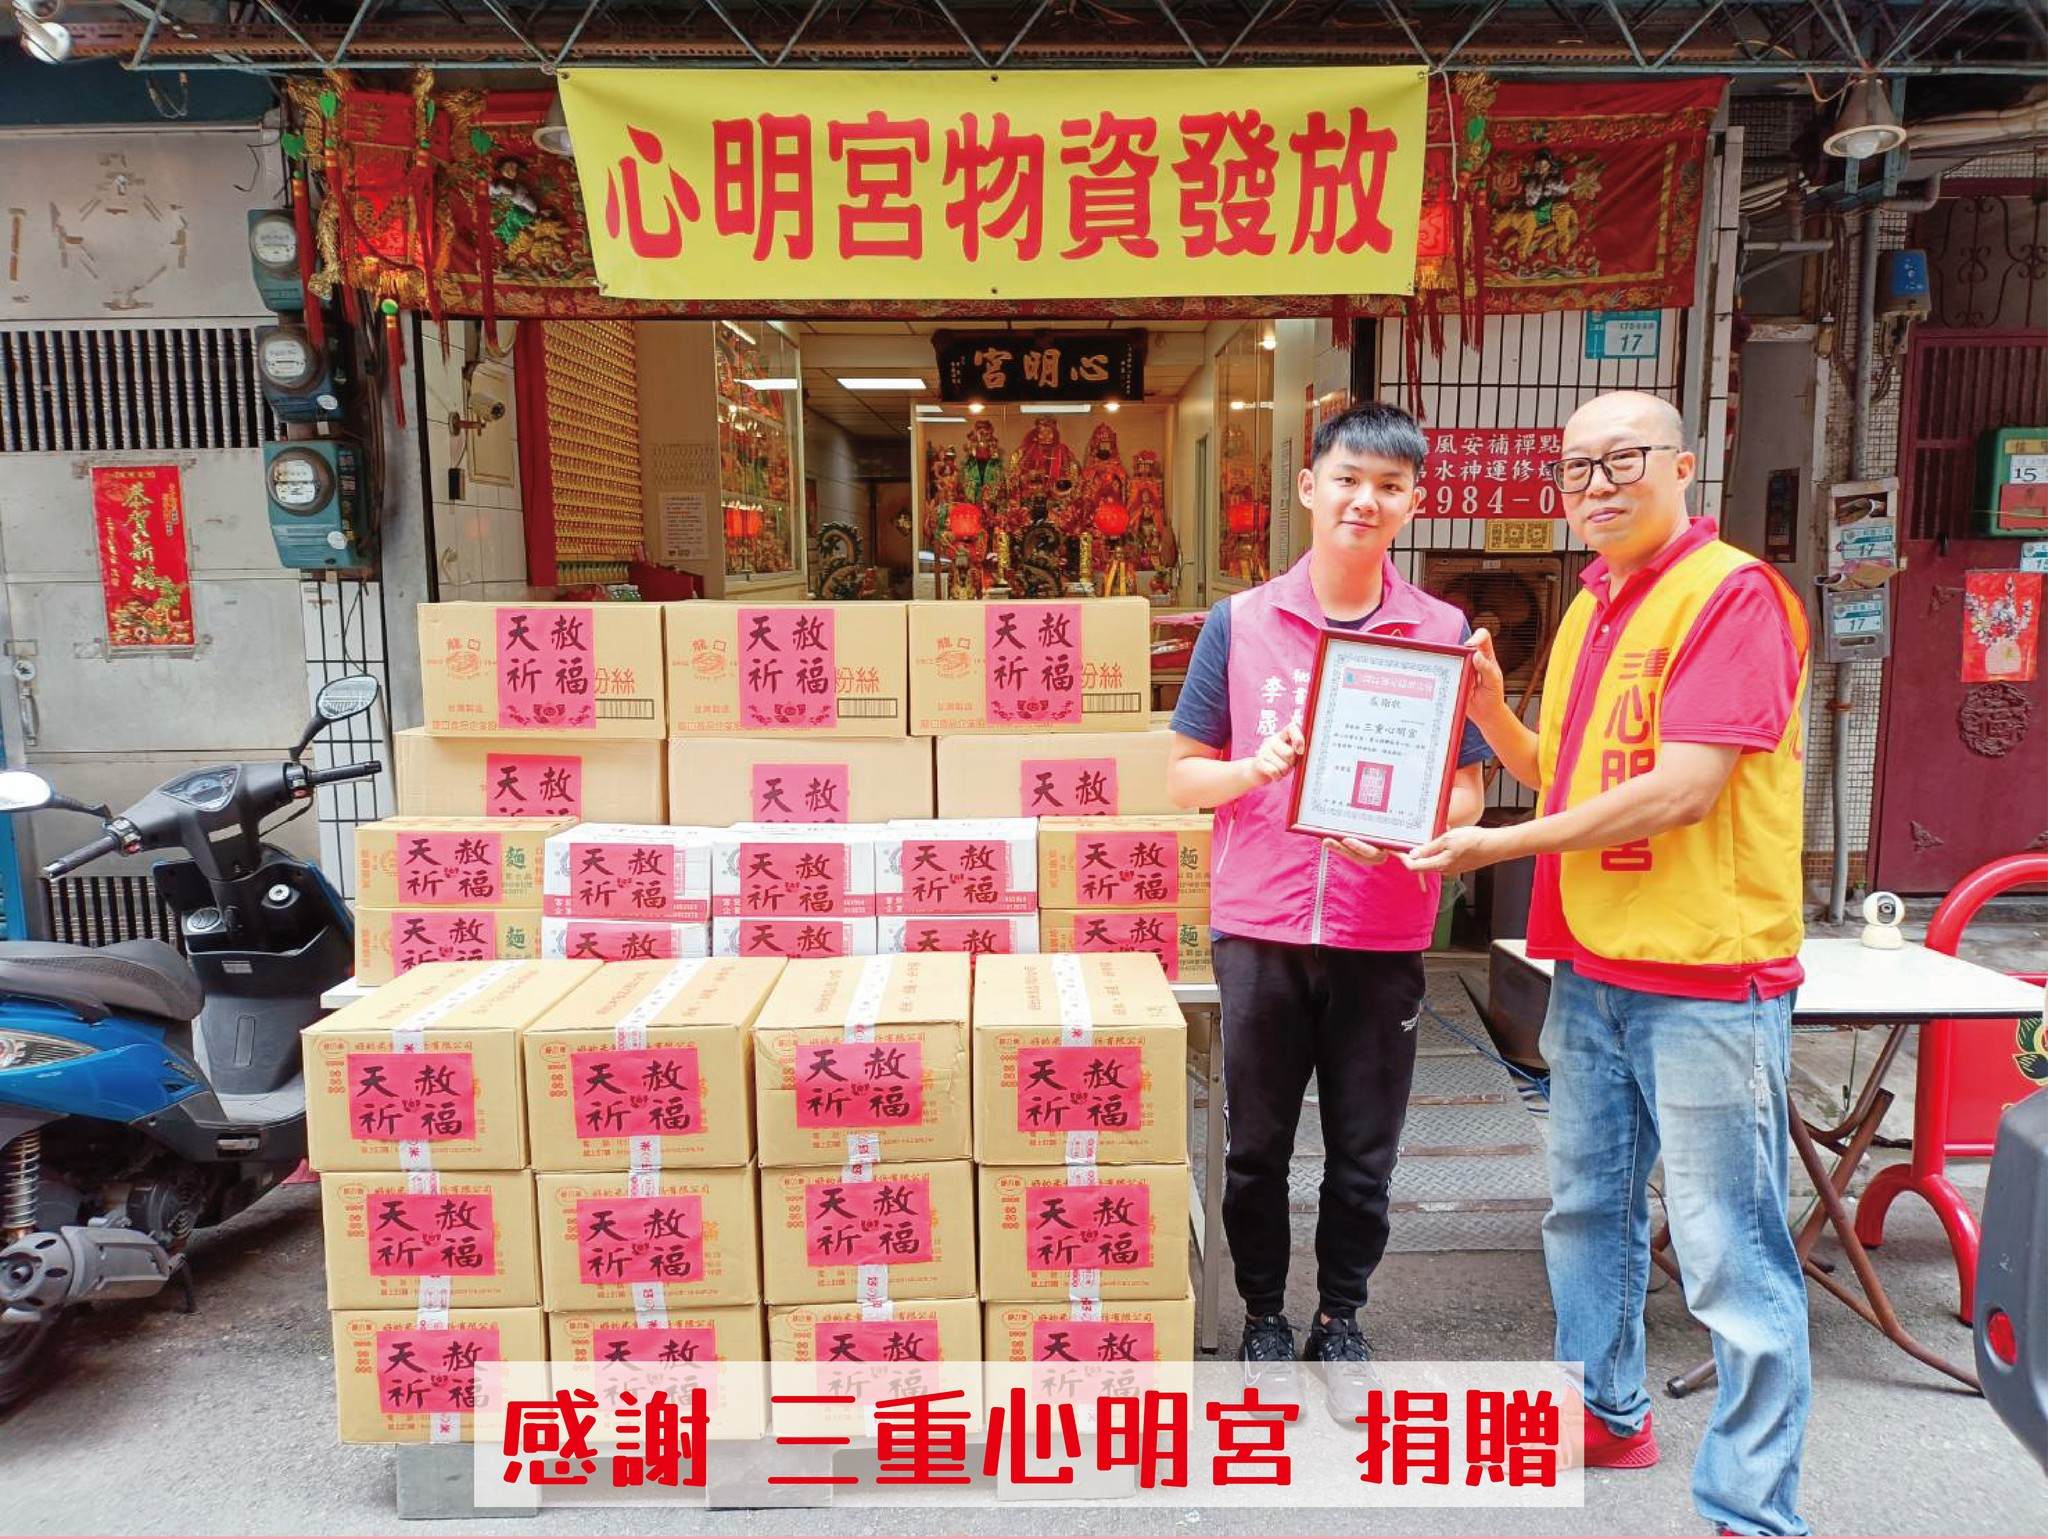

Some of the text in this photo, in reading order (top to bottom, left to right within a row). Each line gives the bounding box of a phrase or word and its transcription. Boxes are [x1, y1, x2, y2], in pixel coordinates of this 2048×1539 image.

[606, 108, 1397, 261] 心明宮物資發放
[1621, 334, 1643, 353] 17
[2015, 468, 2037, 482] 15
[1860, 544, 1875, 557] 17
[506, 615, 587, 652] 天赦
[747, 615, 828, 652] 天赦
[992, 612, 1074, 650] 天赦
[1850, 618, 1865, 631] 17
[507, 658, 589, 695] 祈福
[748, 658, 829, 695] 祈福
[993, 655, 1074, 692] 祈福
[494, 765, 577, 802] 天赦
[760, 777, 839, 814] 天赦
[1031, 771, 1107, 808] 天赦
[406, 838, 494, 866] 天赦
[579, 848, 666, 876] 天赦
[747, 853, 833, 880] 天赦
[912, 844, 999, 872] 天赦
[1082, 842, 1167, 870] 天赦
[407, 870, 494, 898] 祈福
[580, 880, 667, 909] 祈福
[747, 884, 833, 913] 祈福
[912, 875, 998, 904] 祈福
[1083, 872, 1168, 901] 祈福
[401, 918, 489, 945] 天赦
[573, 932, 660, 959] 天赦
[750, 925, 838, 952] 天赦
[917, 929, 998, 954] 天赦
[1083, 917, 1168, 945] 天赦
[356, 1065, 461, 1098] 天赦
[583, 1060, 688, 1096] 天赦
[805, 1047, 910, 1083] 天赦
[1025, 1058, 1129, 1091] 天赦
[586, 1096, 690, 1133] 祈福
[806, 1085, 911, 1119] 祈福
[1025, 1094, 1128, 1128] 祈福
[359, 1102, 463, 1136] 祈福
[376, 1199, 483, 1232] 天赦
[814, 1185, 919, 1221] 天赦
[1035, 1196, 1139, 1231] 天赦
[585, 1208, 690, 1242] 天赦
[816, 1221, 920, 1256] 祈福
[377, 1236, 483, 1269] 祈福
[587, 1244, 691, 1278] 祈福
[1037, 1232, 1139, 1266] 祈福
[384, 1340, 488, 1374] 天赦
[602, 1339, 704, 1372] 天赦
[828, 1331, 927, 1364] 天赦
[1040, 1331, 1142, 1364] 天赦
[387, 1378, 491, 1409] 祈福
